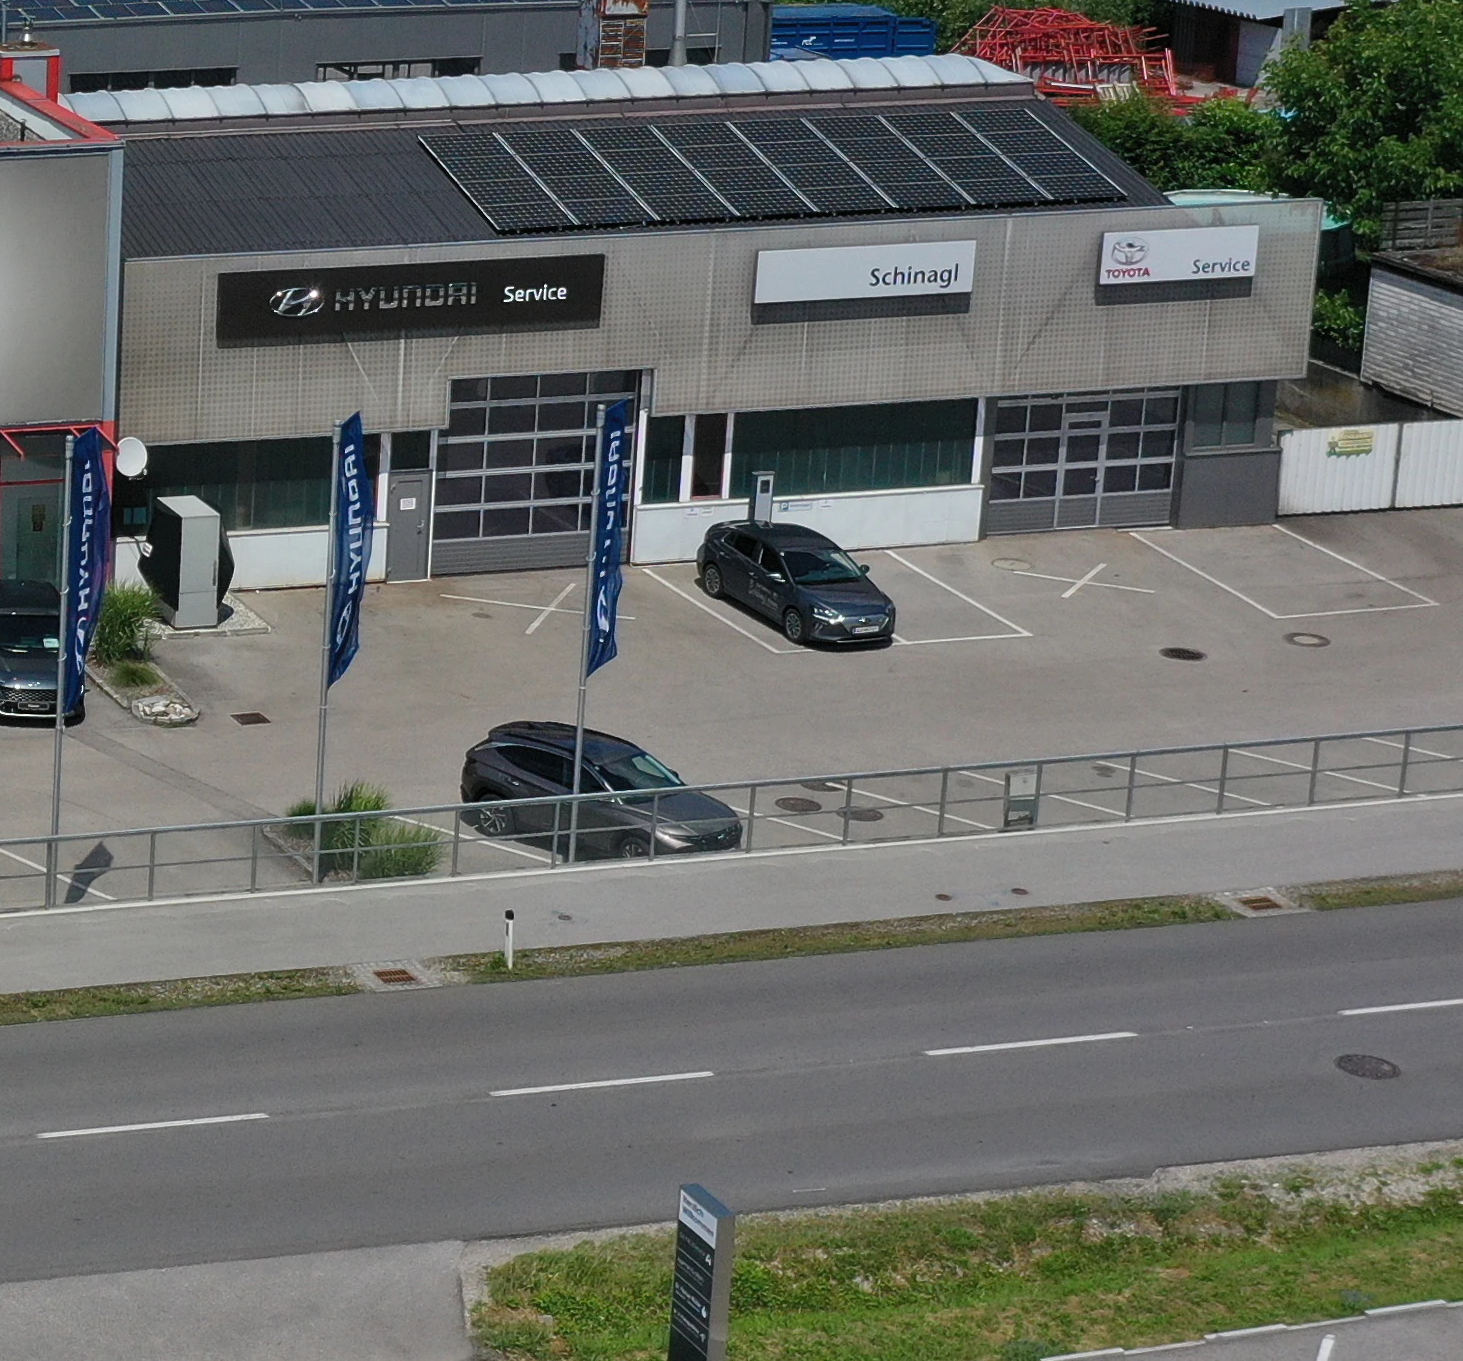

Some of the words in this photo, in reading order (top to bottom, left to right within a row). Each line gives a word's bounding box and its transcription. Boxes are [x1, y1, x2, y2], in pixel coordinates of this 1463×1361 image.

[869, 263, 960, 290] Schinagl
[1105, 267, 1151, 279] TOYOTA
[1191, 257, 1251, 275] Service
[333, 282, 478, 312] HYUNDAI
[503, 283, 568, 304] Service
[343, 444, 363, 595] HYUNDAI
